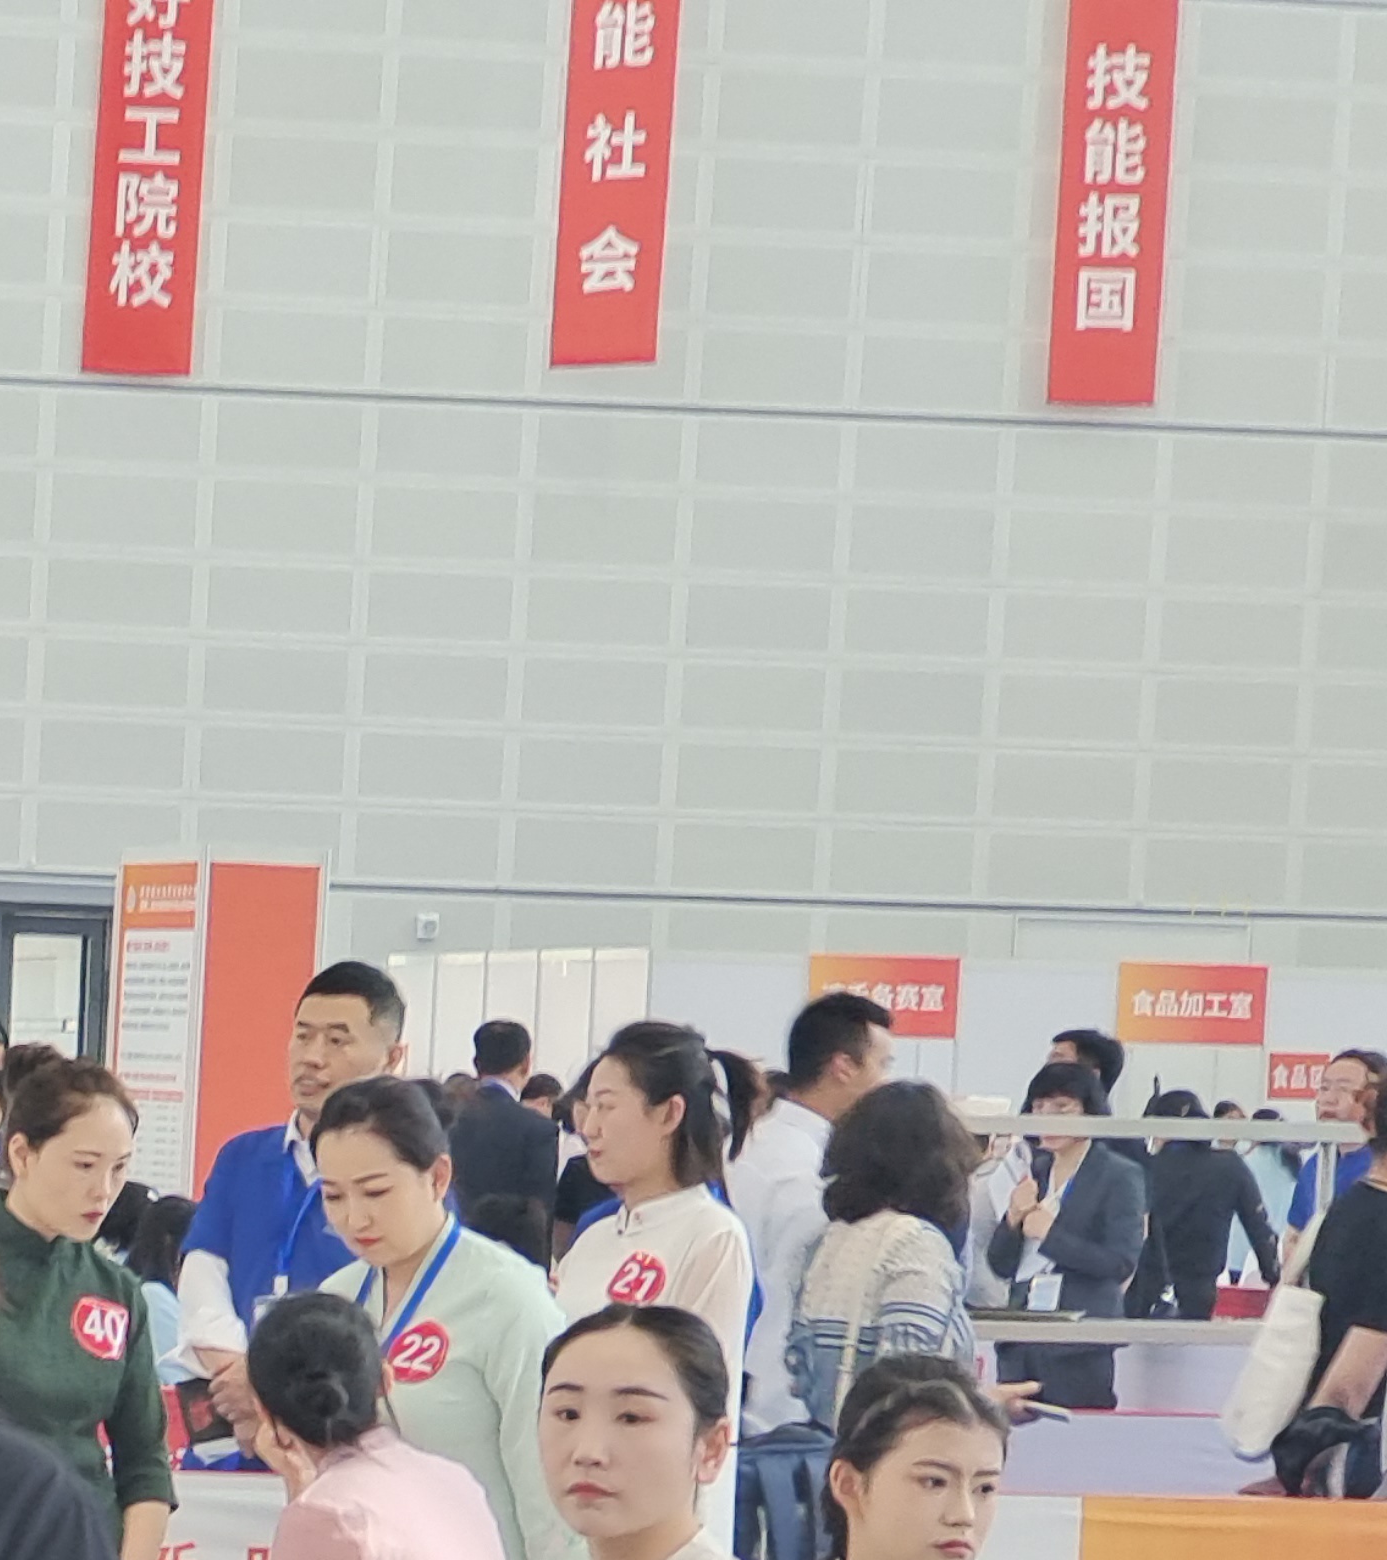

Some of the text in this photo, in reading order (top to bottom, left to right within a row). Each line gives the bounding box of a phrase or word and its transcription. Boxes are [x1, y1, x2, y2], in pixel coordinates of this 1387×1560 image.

[1075, 42, 1152, 333] 技能报国
[612, 1260, 658, 1304] 21
[82, 1307, 125, 1346] 40
[392, 1333, 441, 1372] 22
